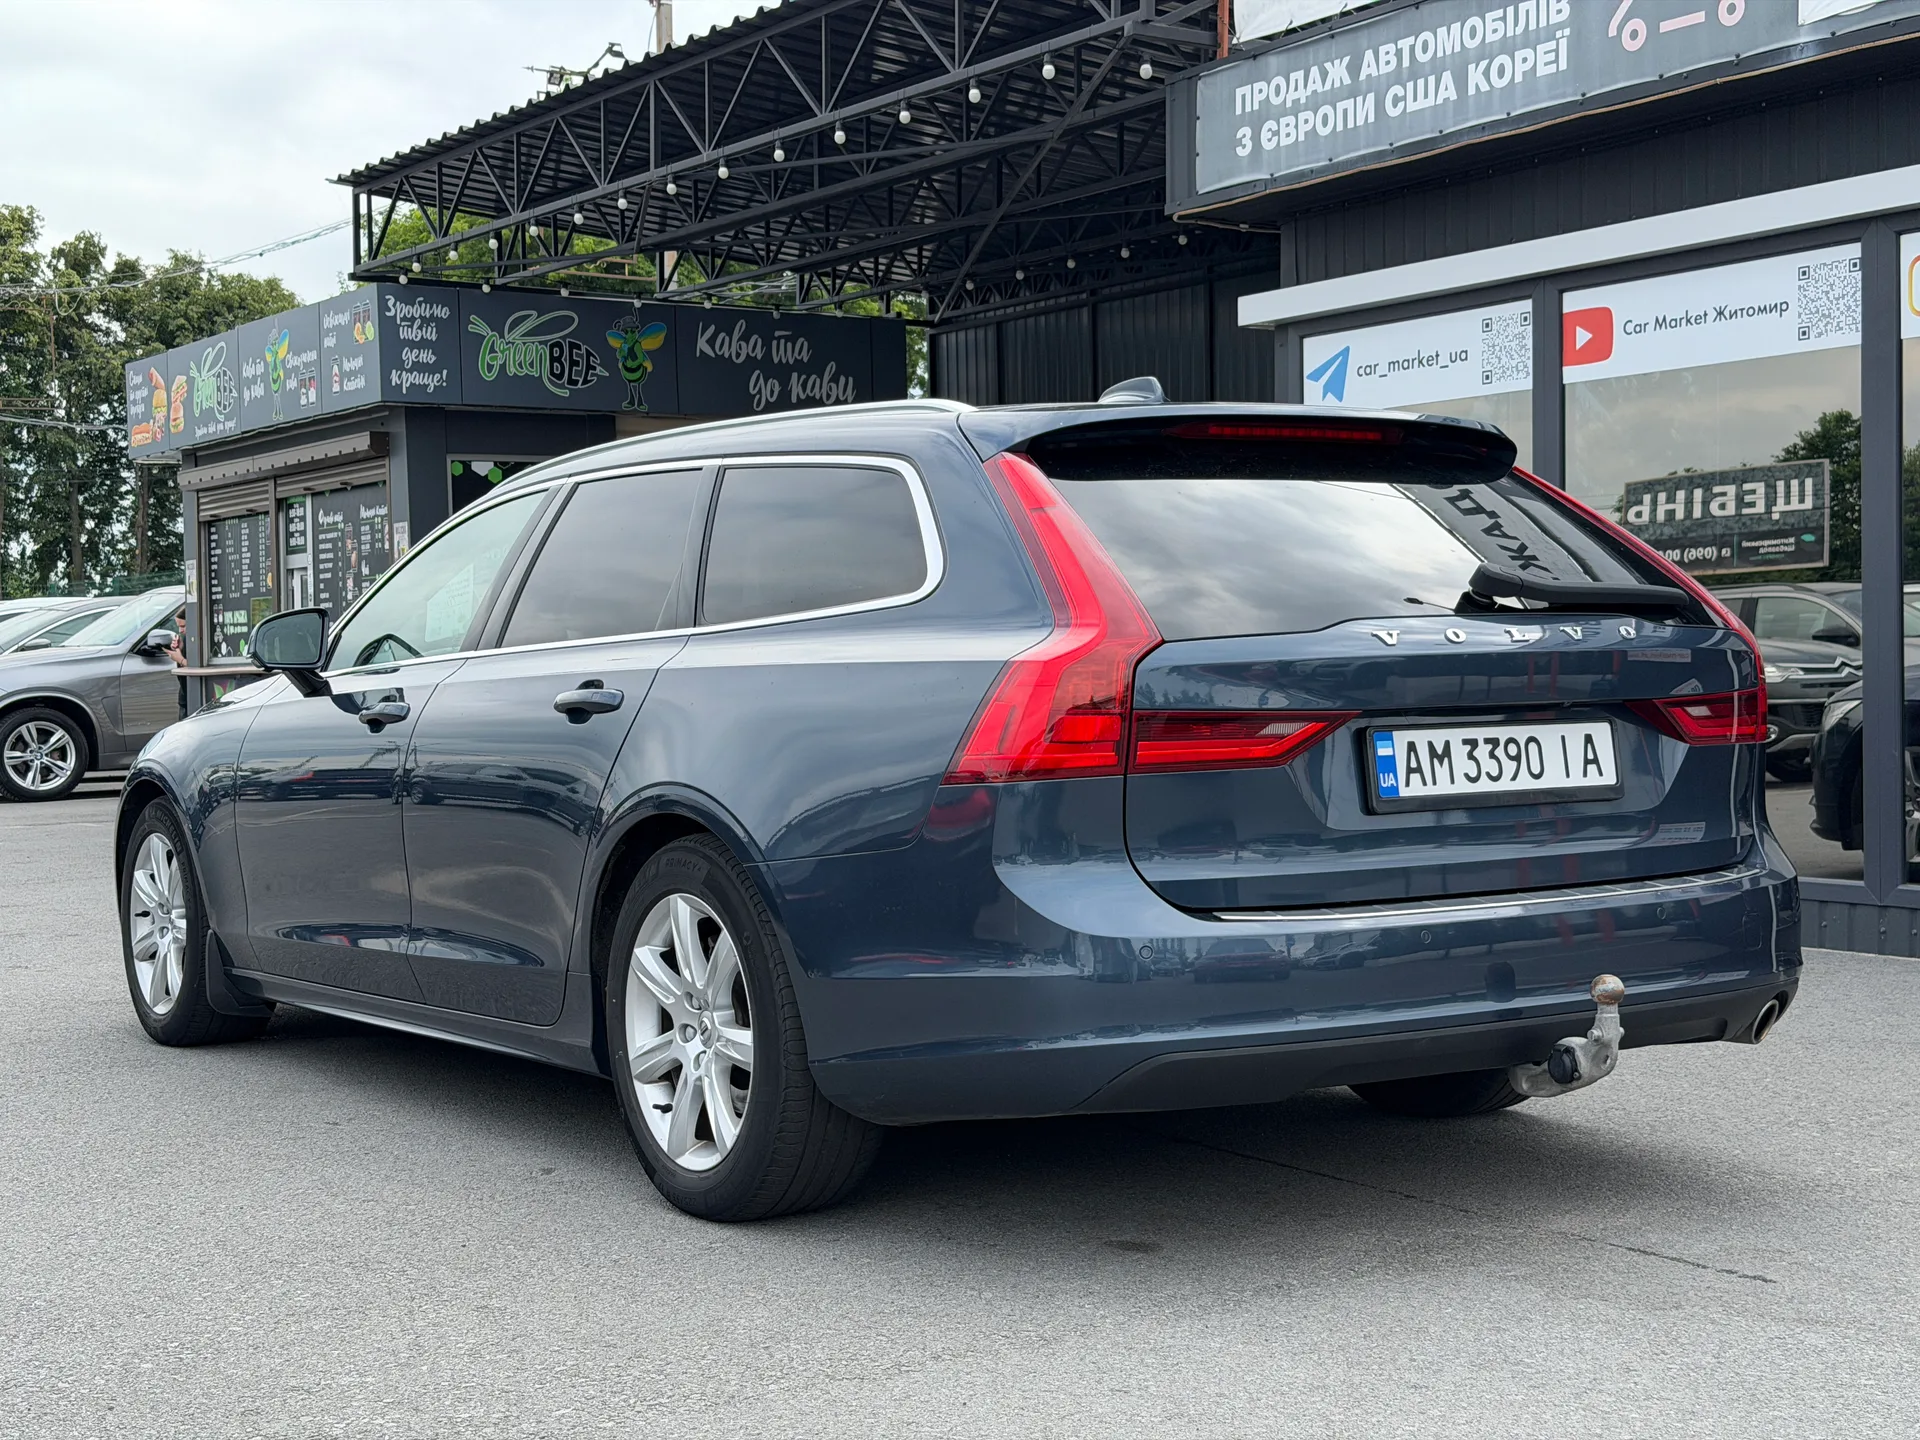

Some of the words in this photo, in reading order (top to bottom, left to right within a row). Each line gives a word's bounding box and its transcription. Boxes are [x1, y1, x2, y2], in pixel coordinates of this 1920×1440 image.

[1235, 55, 1352, 115] ПРОДАЖ
[1358, 0, 1571, 81] АВТОМОБІЛІВ
[1235, 126, 1252, 157] З
[1260, 92, 1375, 150] ЄВРОПИ
[1384, 70, 1458, 117] США
[1467, 28, 1571, 96] КОРЕЇ
[384, 294, 451, 325] Зробимо
[1622, 317, 1650, 338] Car
[1653, 309, 1709, 333] Market
[1712, 299, 1790, 323] Житомир
[399, 318, 438, 342] твій
[696, 319, 766, 364] Кава
[771, 330, 813, 365] та
[401, 346, 437, 369] день
[1355, 346, 1469, 380] car_market_ua
[389, 369, 448, 395] краще!
[749, 369, 782, 412] до
[788, 361, 857, 405] кави
[1371, 624, 1638, 647] VOLVO
[1404, 738, 1455, 788] AM
[1461, 735, 1545, 784] 3390
[1380, 772, 1397, 787] UA
